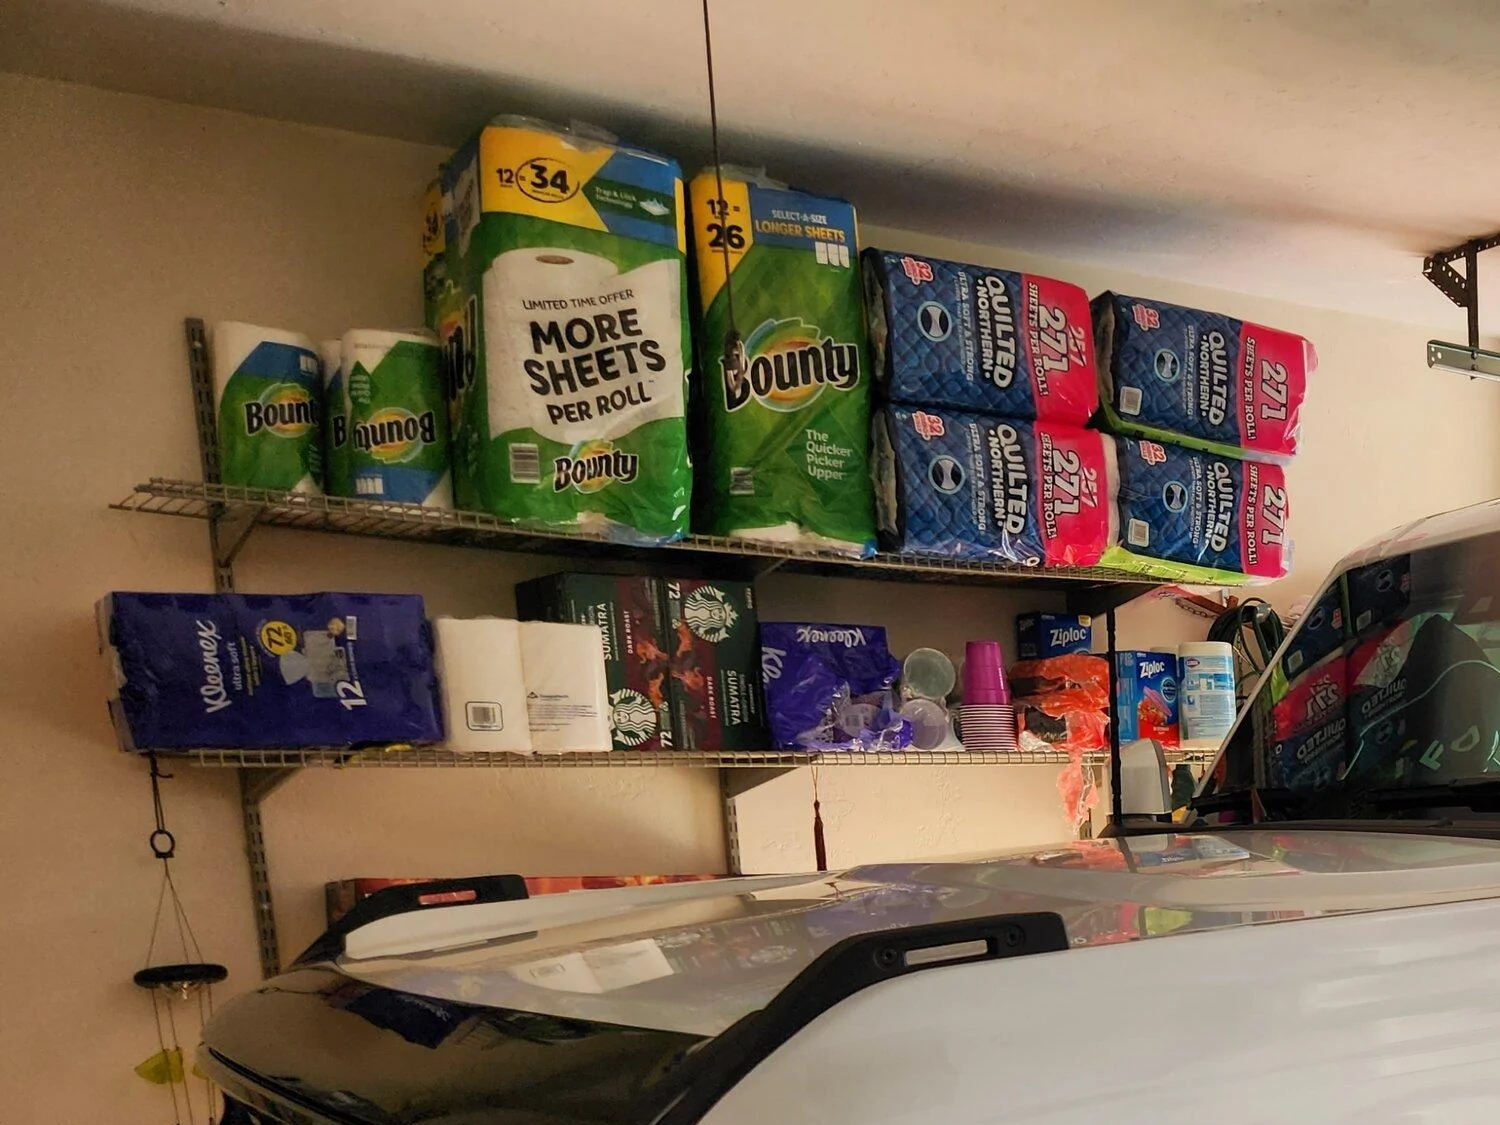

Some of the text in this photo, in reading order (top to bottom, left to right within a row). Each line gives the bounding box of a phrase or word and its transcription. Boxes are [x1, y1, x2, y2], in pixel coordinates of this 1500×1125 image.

[496, 168, 515, 184] 12
[530, 162, 570, 195] 34
[706, 223, 746, 249] 26
[756, 220, 845, 243] LONGER SHEETS
[522, 289, 634, 310] LIMITED TIME OFFER
[1028, 282, 1039, 330] SHEETS
[529, 308, 643, 354] MORE
[976, 286, 994, 373] NORTHERN
[986, 276, 1017, 388] QUILTED
[1029, 331, 1040, 356] PER
[1038, 305, 1070, 372] 271
[523, 340, 666, 396] SHEETS
[721, 338, 859, 411] Bounty
[1199, 340, 1210, 412] NORTHERN
[1208, 331, 1227, 425] QUILTED
[1244, 337, 1256, 378] SHEETS
[546, 382, 652, 425] PER ROLL
[1244, 379, 1254, 402] PER
[1260, 358, 1288, 421] 271
[806, 429, 828, 442] The
[806, 441, 853, 457] Quicker
[1040, 432, 1052, 472] SHEETS
[554, 449, 639, 492] Bounty
[807, 454, 845, 468] Picker
[808, 465, 843, 480] Upper
[989, 438, 1006, 521] NORTHERN
[997, 424, 1028, 534] QUILTED
[1043, 475, 1054, 500] PER
[1052, 448, 1081, 516] 271
[1248, 464, 1258, 504] SHEETS
[1205, 469, 1217, 540] NORTHERN
[1211, 461, 1235, 552] QUILTED
[1246, 506, 1256, 528] PER
[1262, 484, 1286, 546] 271
[668, 582, 680, 599] 72
[267, 626, 284, 648] 72
[597, 603, 611, 660] SUMATRA
[623, 610, 632, 633] ROAST
[797, 625, 867, 648] Kleenex
[1050, 626, 1087, 647] Ziploc
[196, 619, 232, 714] Kleenex
[228, 641, 244, 691] ultra soft
[1139, 661, 1165, 679] Ziploc
[336, 680, 368, 711] 12
[727, 670, 741, 725] SUMATRA
[660, 730, 673, 748] 72
